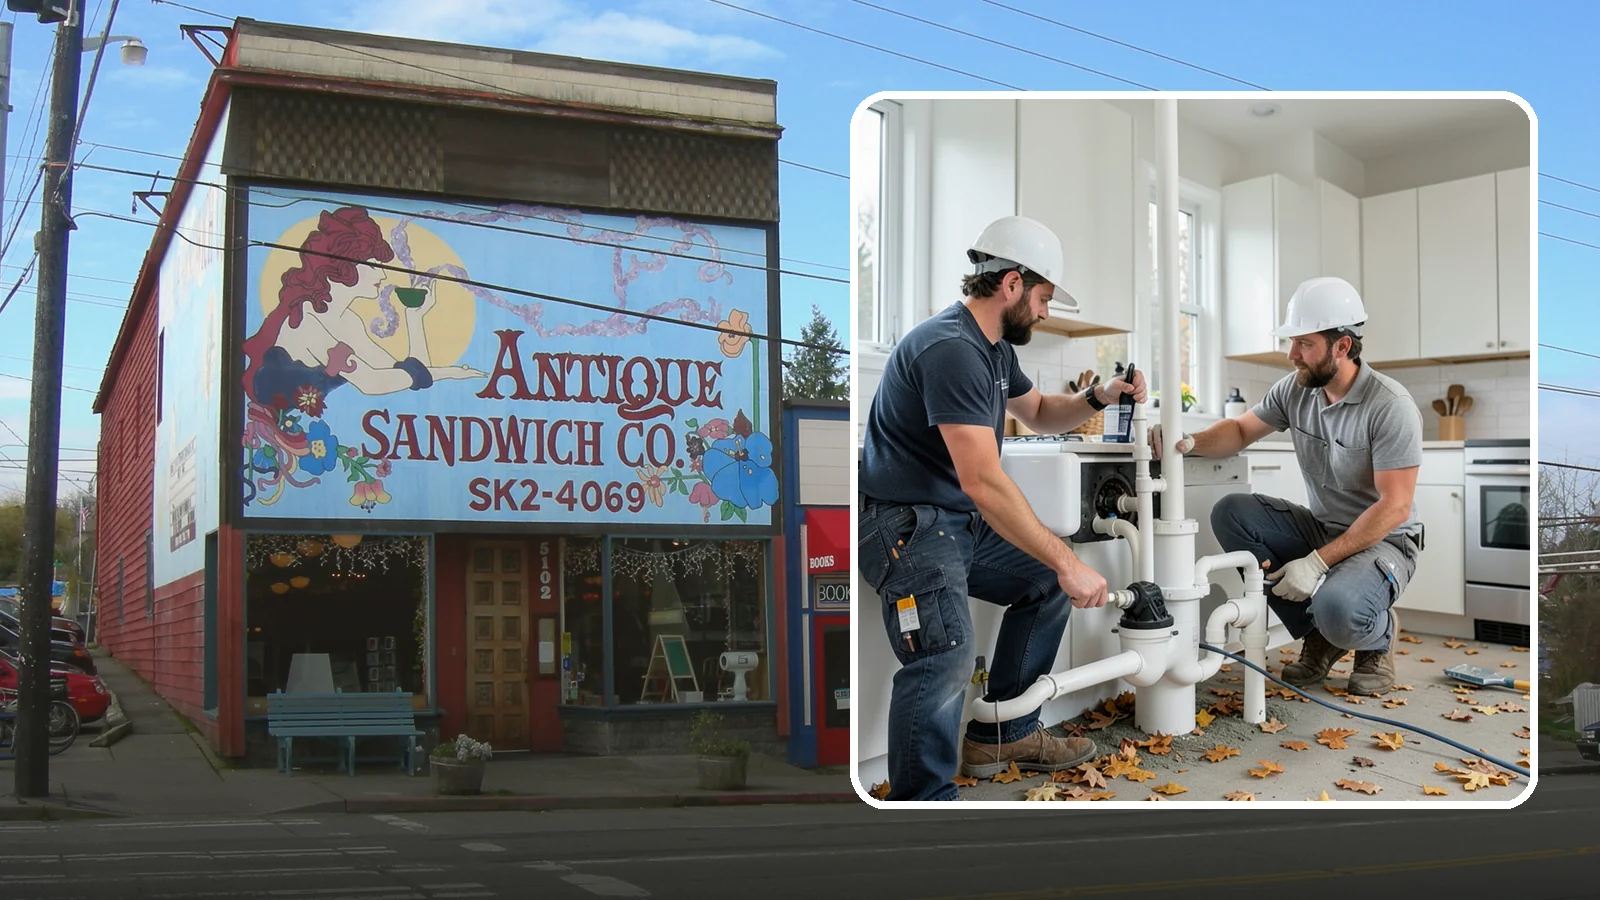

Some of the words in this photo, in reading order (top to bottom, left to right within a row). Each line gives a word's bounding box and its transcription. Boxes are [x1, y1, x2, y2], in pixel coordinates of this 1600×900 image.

[475, 329, 723, 421] ANTIQUE
[361, 409, 605, 467] SANDWICH
[617, 422, 684, 469] CO.
[468, 477, 646, 513] SK2-4069
[540, 542, 551, 599] 5102
[809, 555, 835, 569] BOOKS
